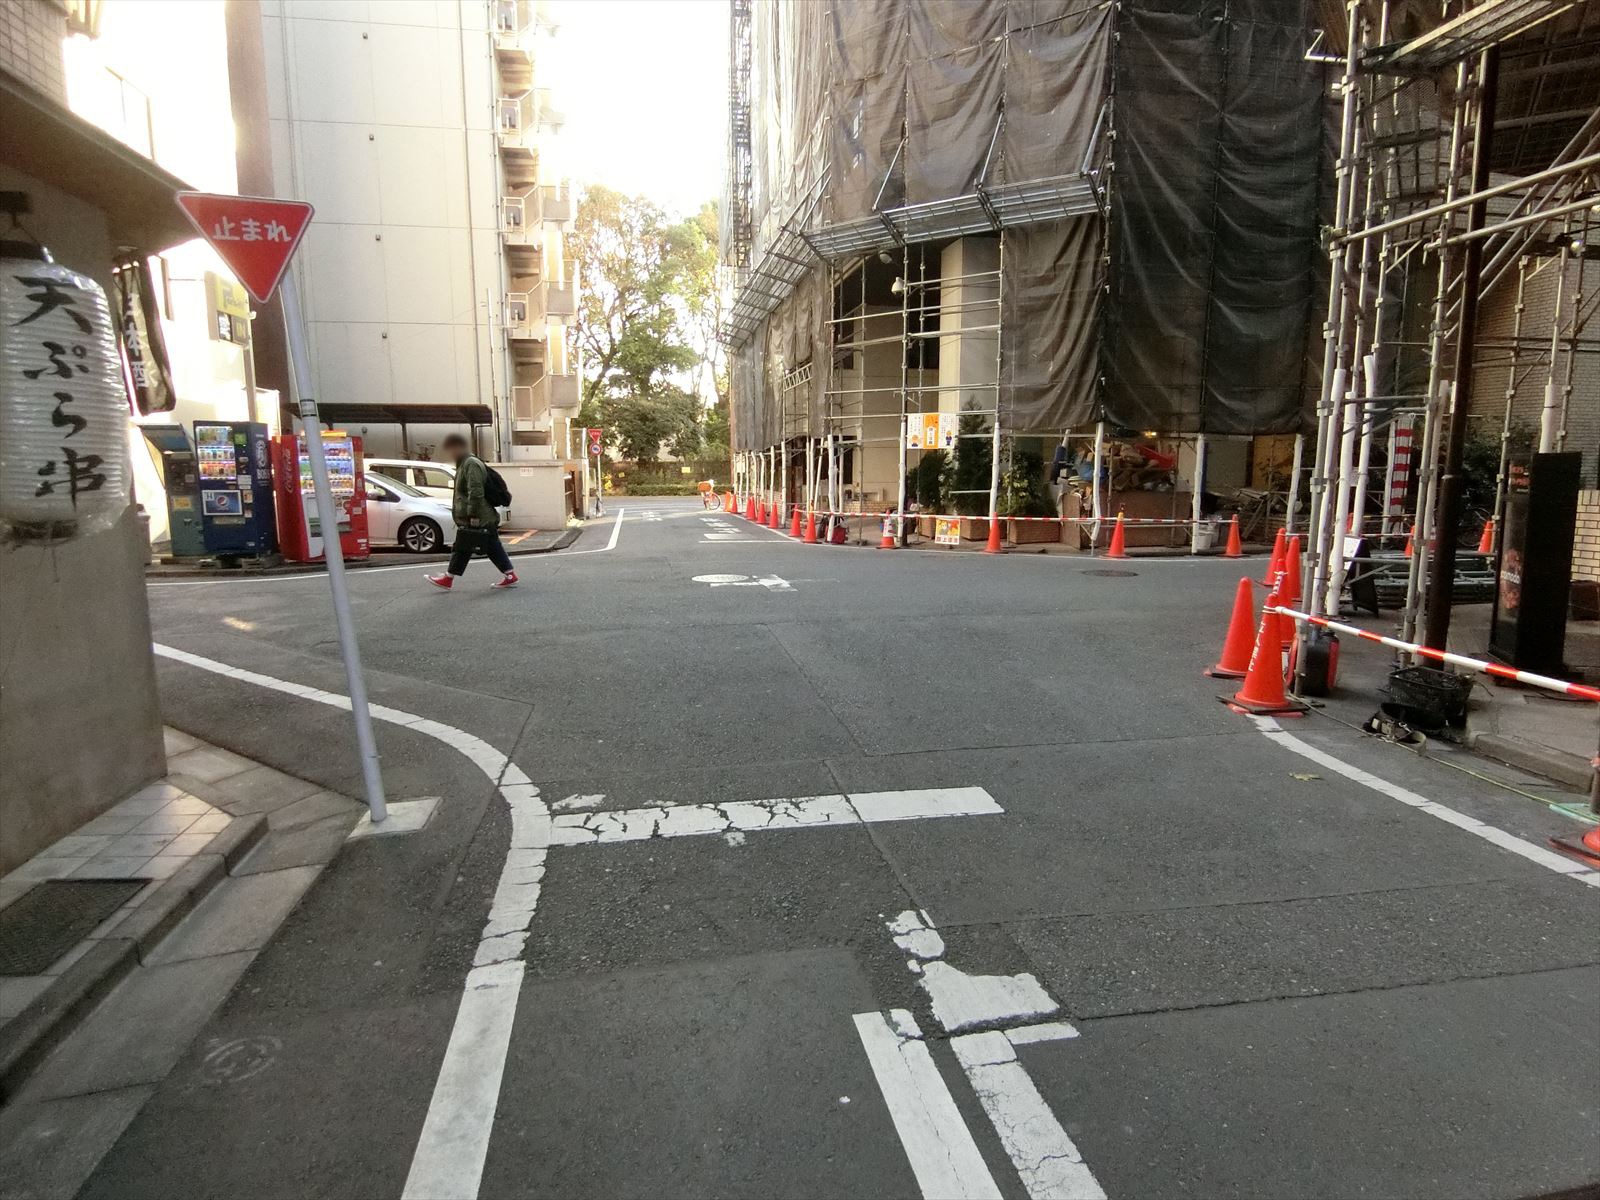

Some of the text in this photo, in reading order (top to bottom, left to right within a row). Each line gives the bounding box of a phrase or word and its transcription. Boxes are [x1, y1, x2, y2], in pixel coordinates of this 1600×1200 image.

[212, 215, 292, 242] 止まれ
[9, 275, 107, 511] 天ぷら串
